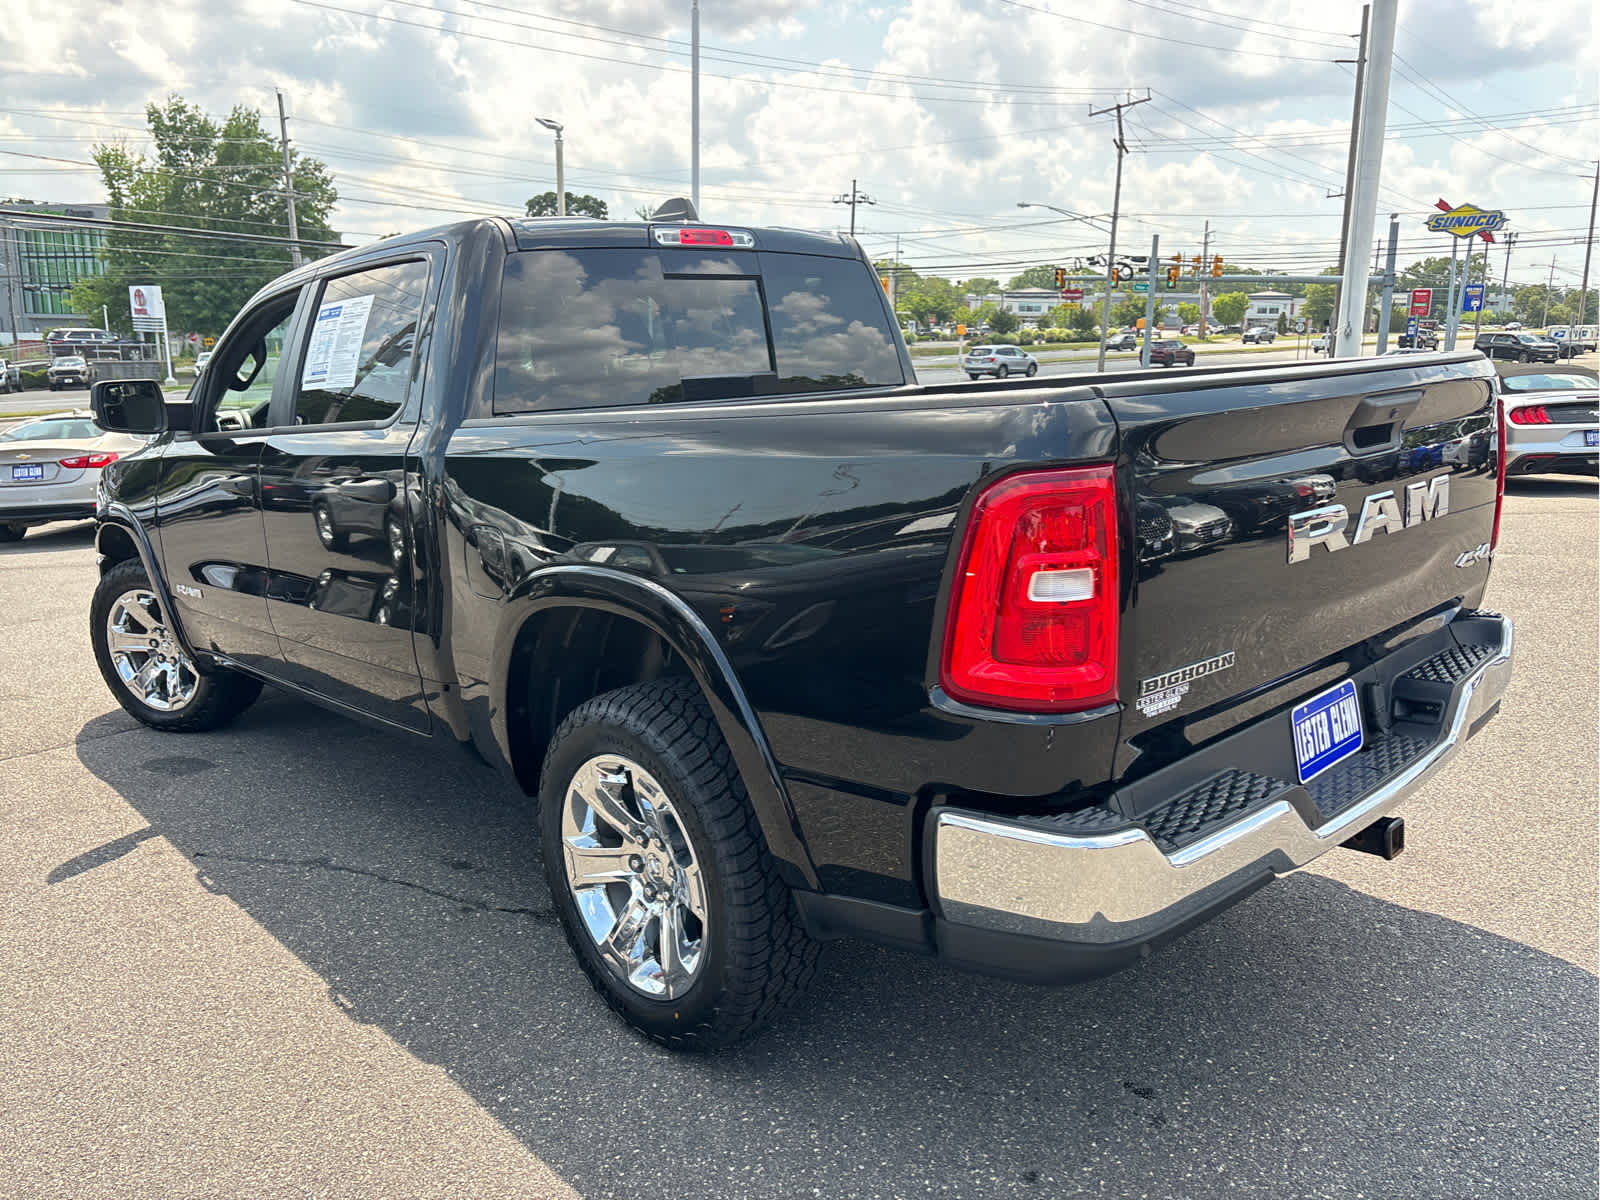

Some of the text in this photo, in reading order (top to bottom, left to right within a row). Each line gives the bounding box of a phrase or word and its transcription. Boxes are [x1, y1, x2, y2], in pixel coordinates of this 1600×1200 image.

[1431, 214, 1498, 229] SUNOCO
[1287, 474, 1450, 564] RAM
[175, 584, 203, 599] RAM
[1143, 652, 1234, 695] BIGHORN
[1296, 695, 1360, 764] LESTER GLENN
